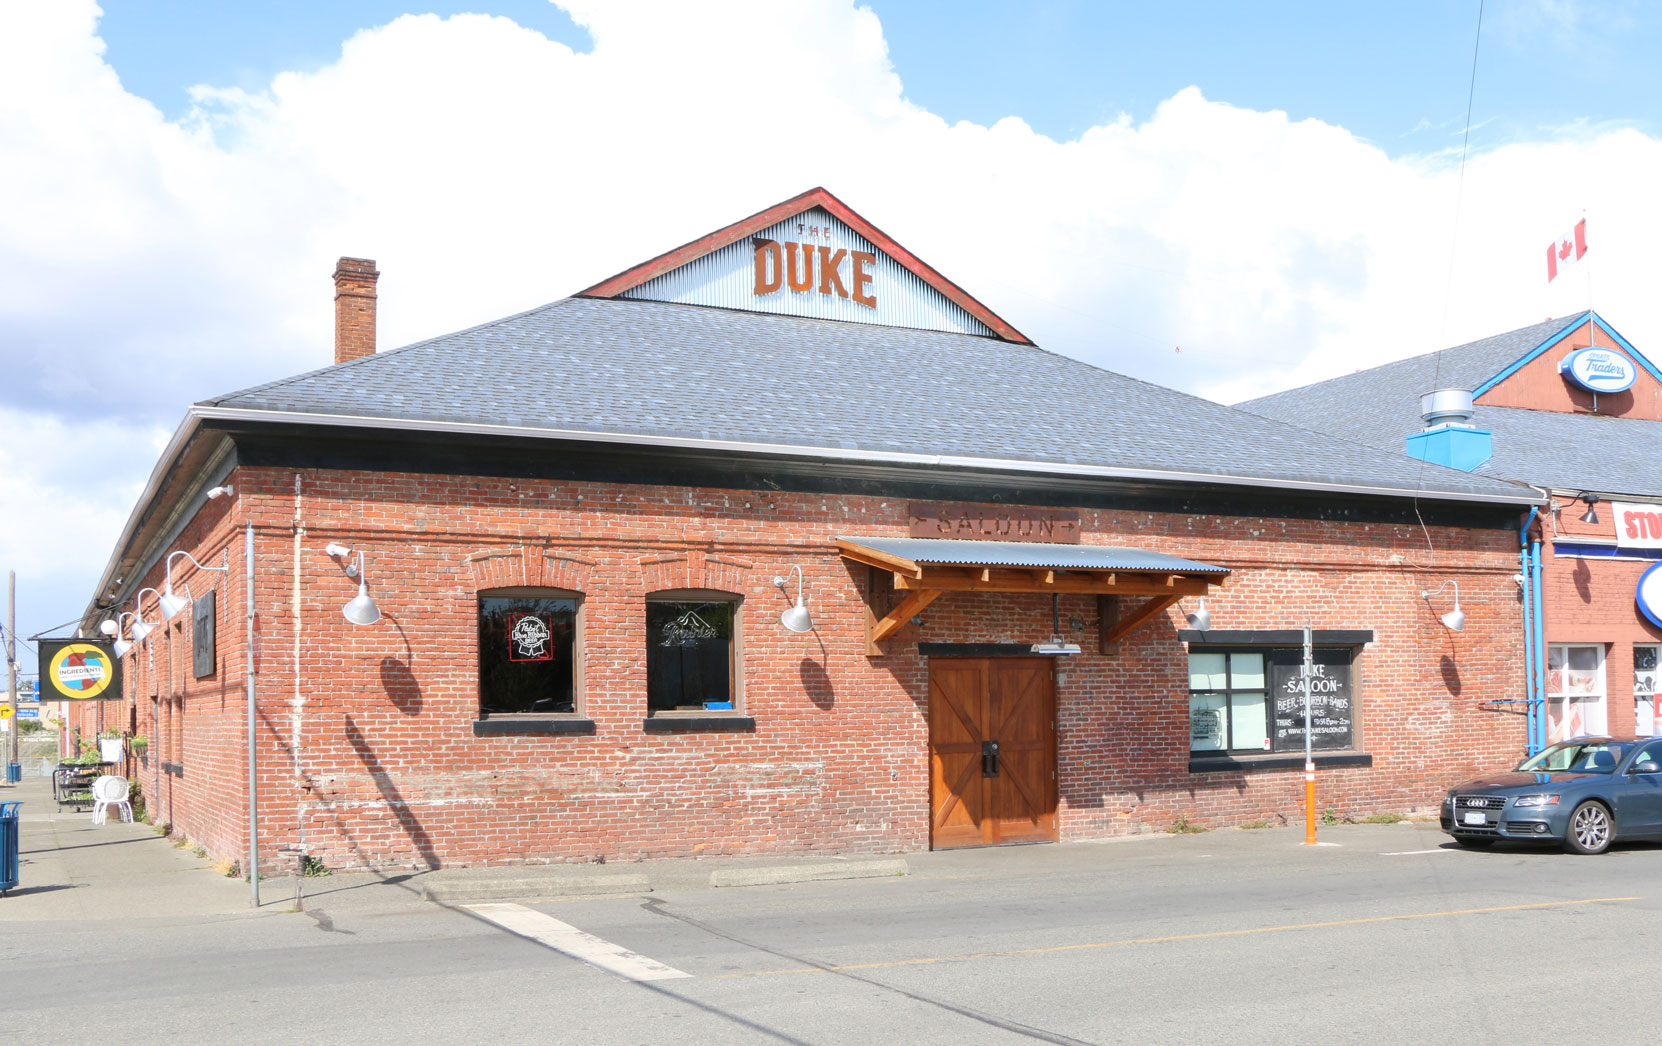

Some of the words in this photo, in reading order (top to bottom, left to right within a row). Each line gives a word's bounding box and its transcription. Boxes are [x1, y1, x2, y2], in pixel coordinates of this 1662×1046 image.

[798, 223, 831, 239] THE
[752, 237, 877, 309] DUKE
[1586, 359, 1625, 376] Traders
[936, 508, 1055, 538] SALOON
[1623, 510, 1662, 540] STO
[521, 622, 541, 632] Pabst
[528, 630, 548, 639] Ribbon
[1300, 664, 1325, 679] DKE
[1287, 680, 1337, 693] SAOON
[1277, 698, 1298, 711] BEER
[1329, 696, 1349, 709] BANDS
[1300, 709, 1325, 717] HURS
